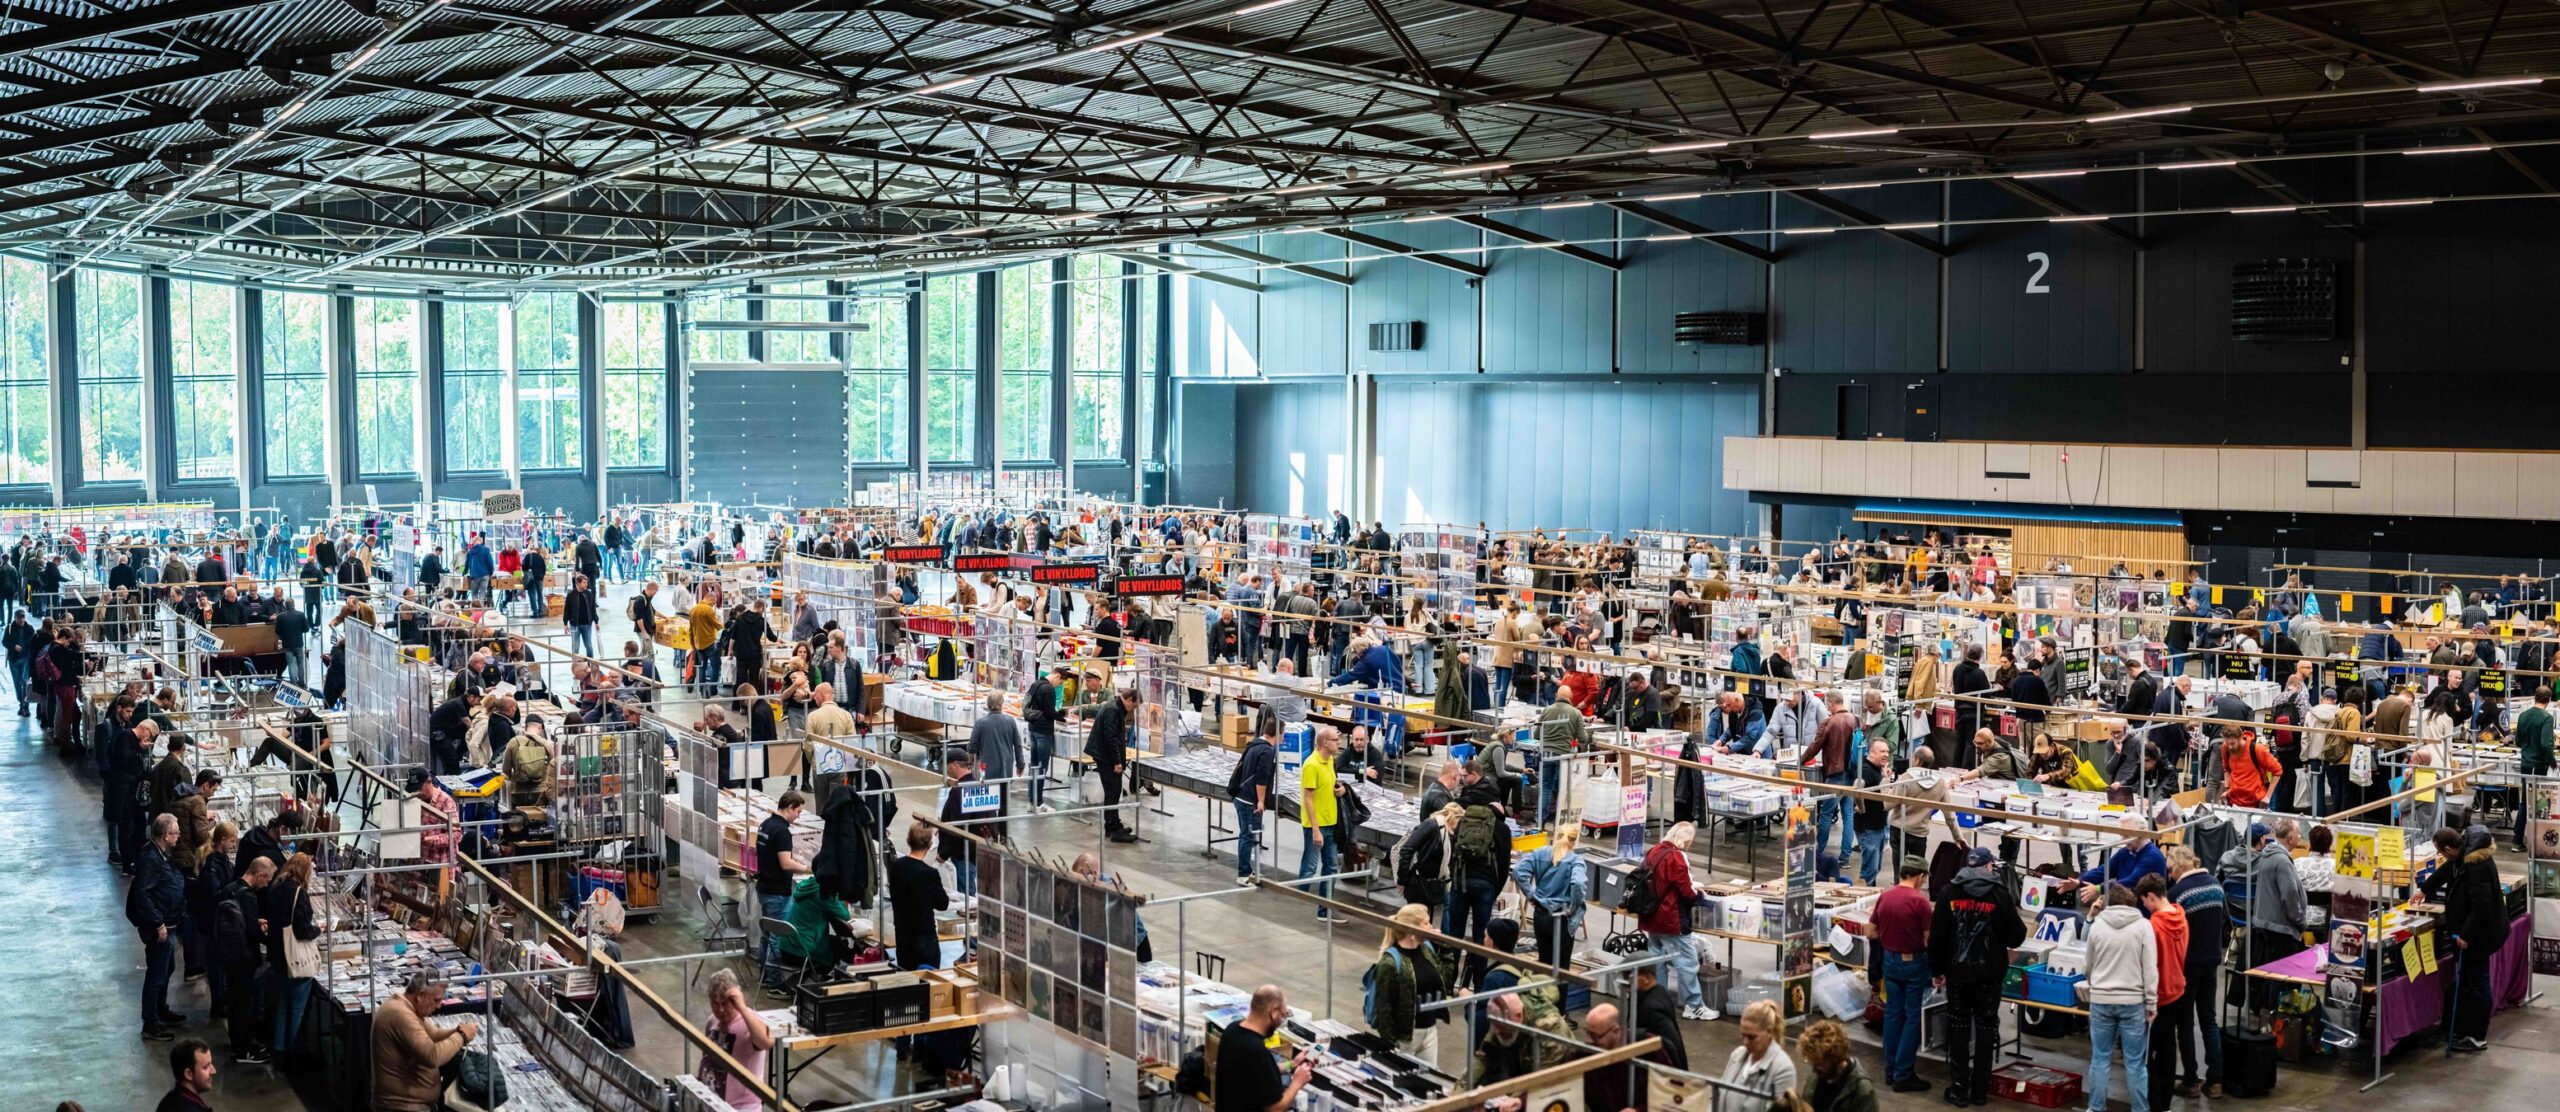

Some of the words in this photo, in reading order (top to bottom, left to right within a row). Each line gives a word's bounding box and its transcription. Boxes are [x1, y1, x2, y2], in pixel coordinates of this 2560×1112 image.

[2026, 252, 2049, 293] 2
[886, 550, 896, 560] DE
[897, 548, 942, 560] VINYLLOODS
[957, 558, 967, 569] DE
[1034, 569, 1045, 580] DE
[1046, 567, 1096, 579] VINYLLOODS
[1119, 581, 1130, 592] DE
[1131, 579, 1183, 592] VINYLLOODS
[197, 632, 216, 645] PINNEN
[276, 692, 284, 701] JA
[280, 684, 302, 699] PINNEN
[963, 785, 989, 798] PINNEN
[963, 797, 973, 808] JA
[974, 795, 999, 807] GRAAG
